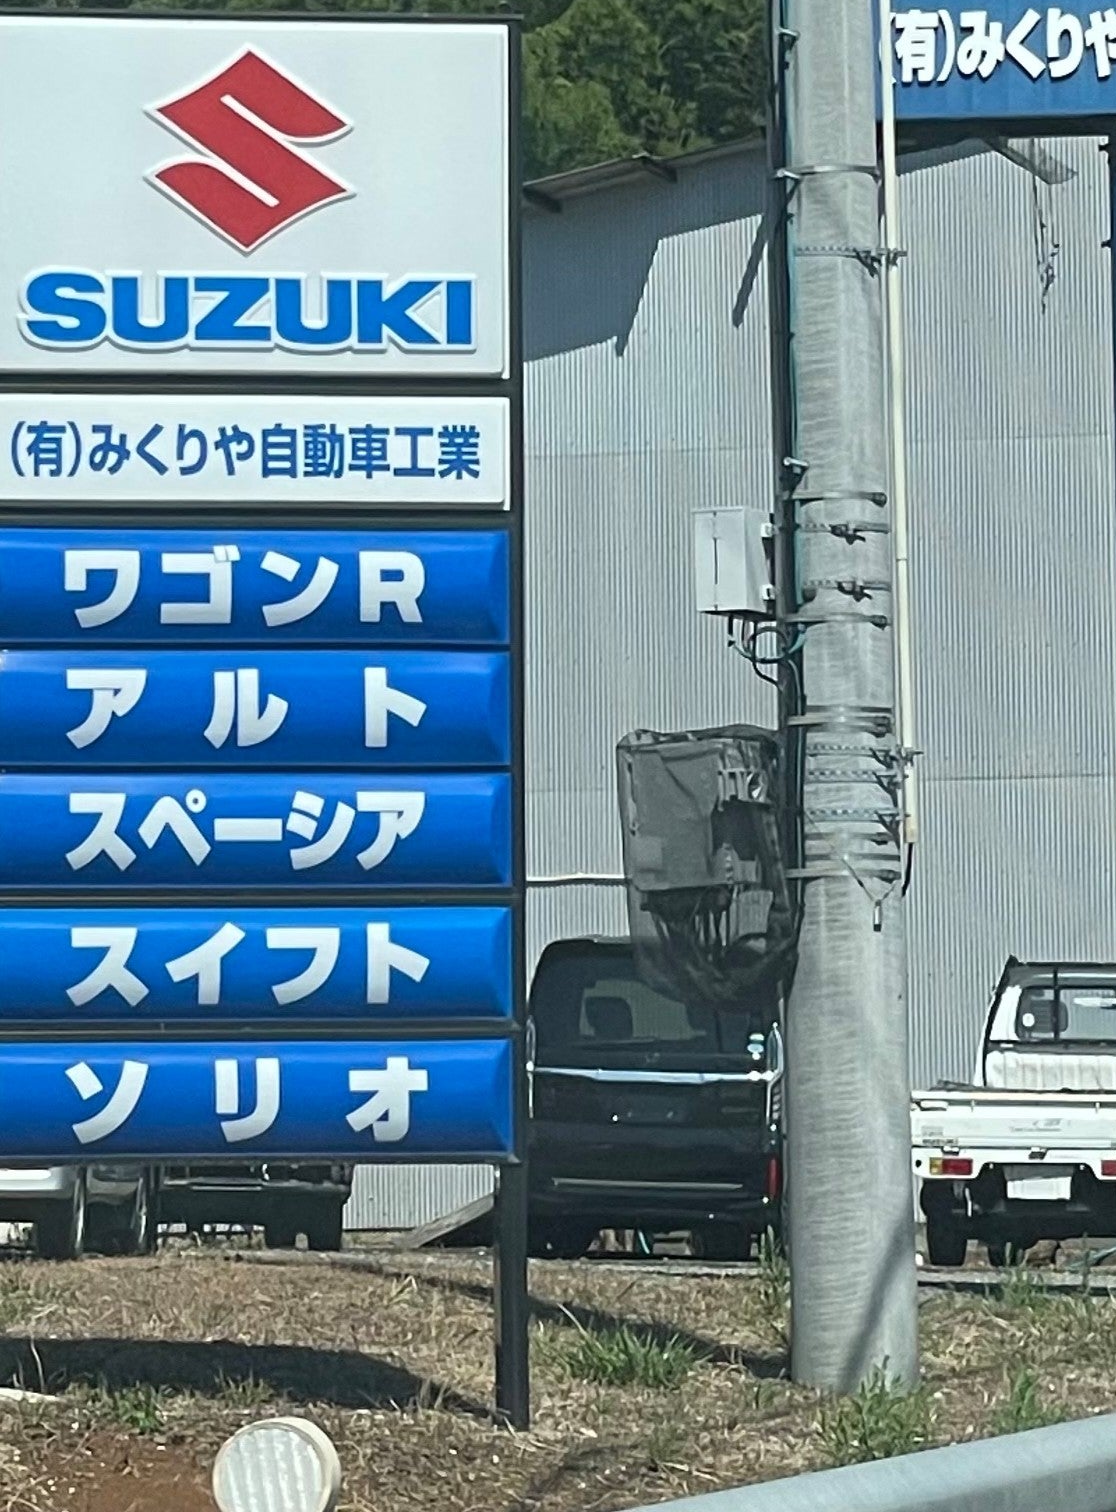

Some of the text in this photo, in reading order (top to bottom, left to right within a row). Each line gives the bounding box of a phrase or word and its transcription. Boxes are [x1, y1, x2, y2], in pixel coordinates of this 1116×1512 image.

[25, 270, 474, 347] SUZUKI
[11, 421, 481, 480] (有)みくりや自動車工業
[63, 545, 426, 629] ワゴンR
[66, 666, 427, 750] アルト
[64, 788, 426, 872] スペーシア
[66, 921, 430, 1007] スイフト
[65, 1058, 428, 1145] ソリオ
